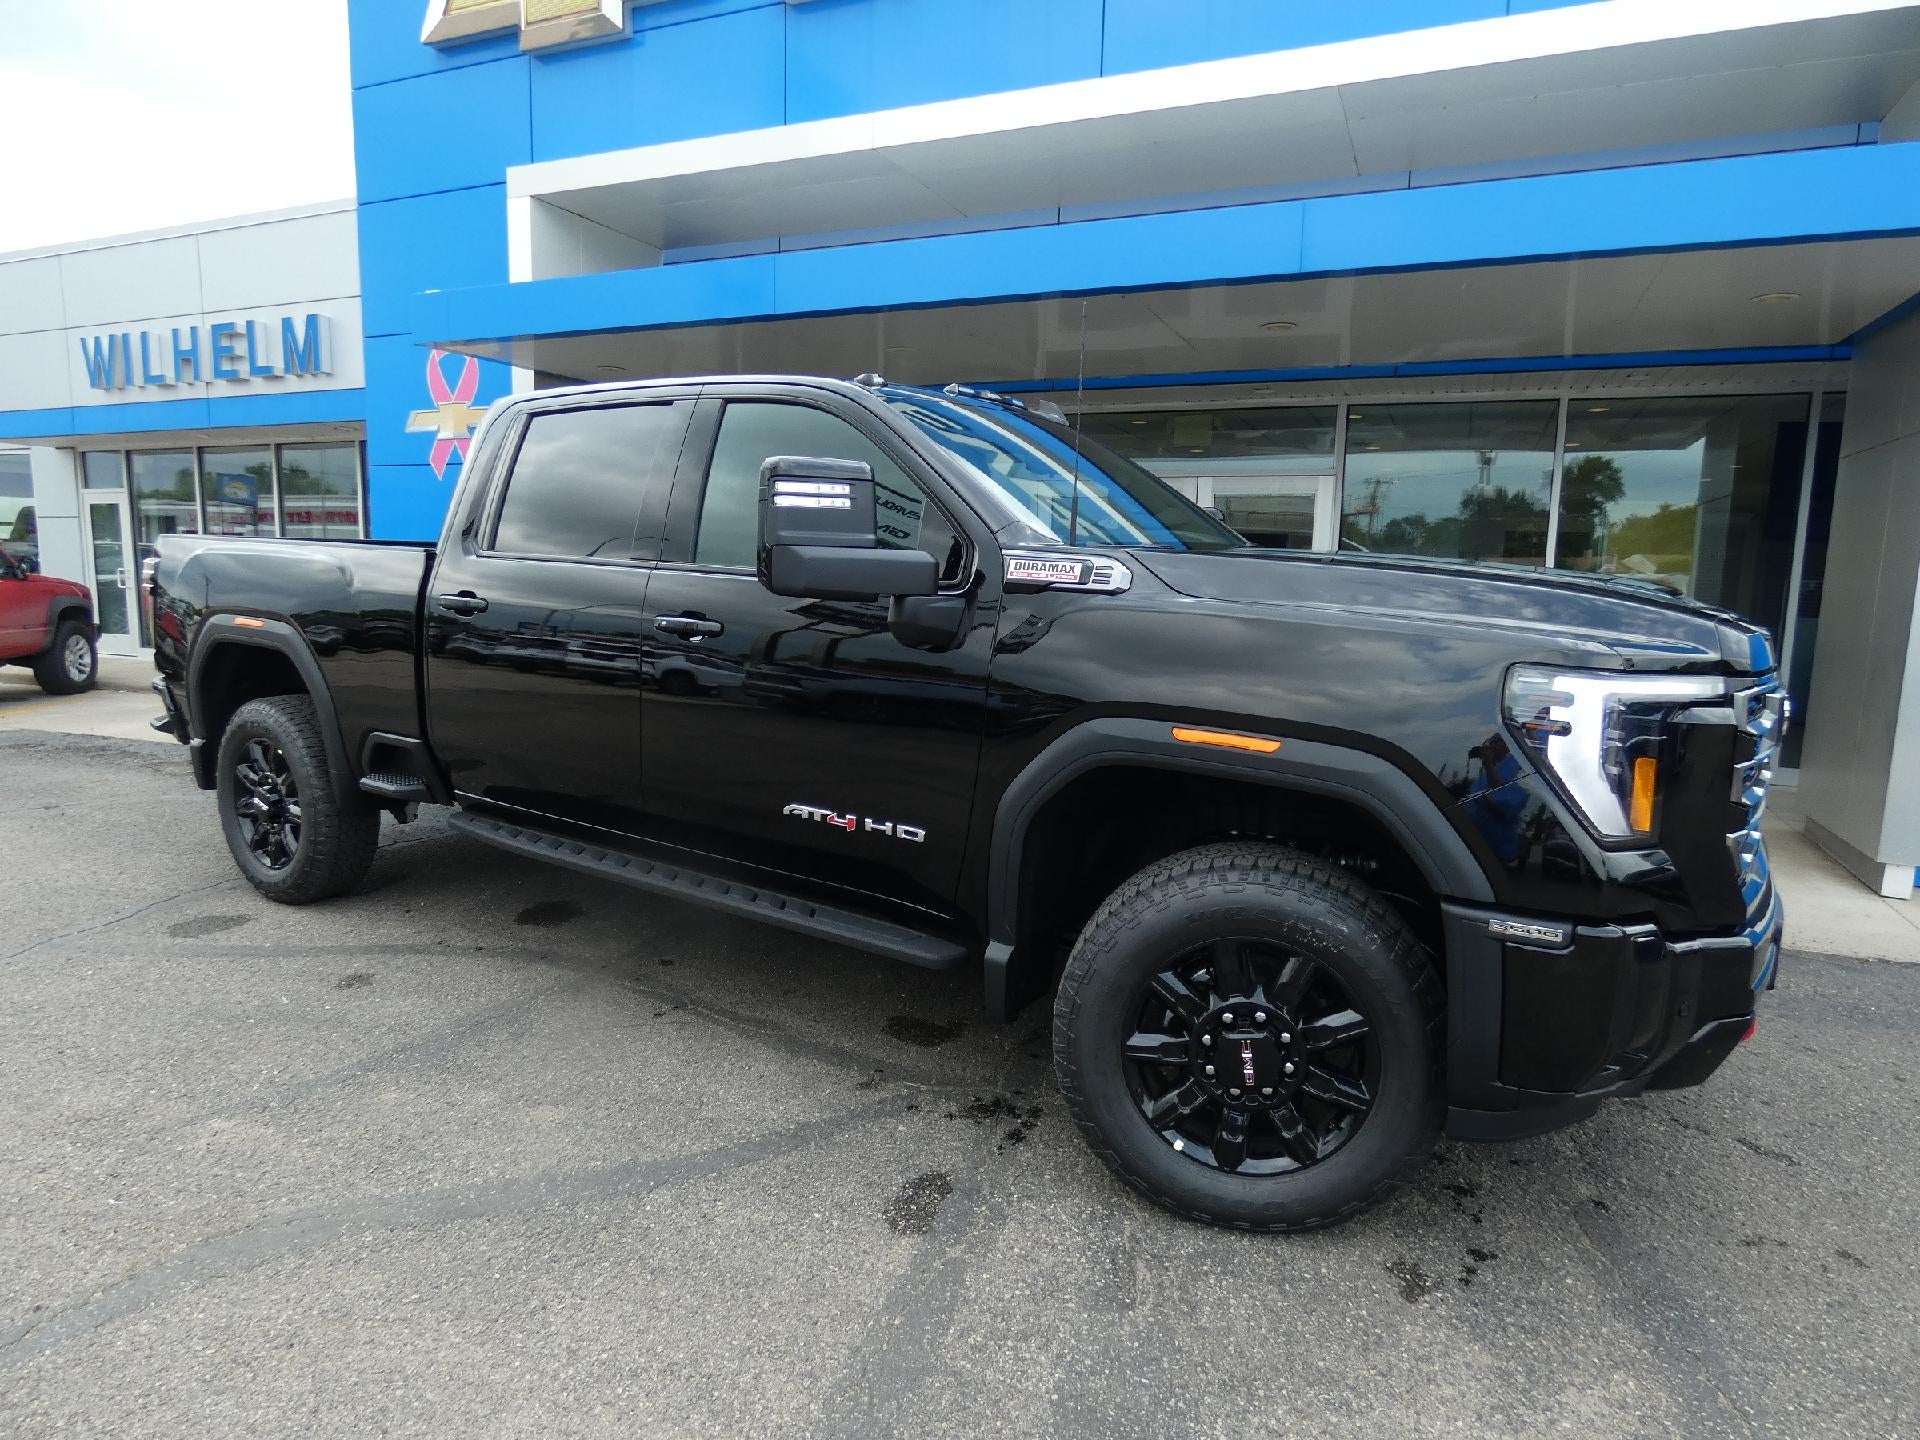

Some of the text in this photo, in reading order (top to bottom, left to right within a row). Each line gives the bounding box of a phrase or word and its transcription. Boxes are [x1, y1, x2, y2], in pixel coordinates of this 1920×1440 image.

[80, 313, 326, 391] WILHELM
[1013, 561, 1076, 574] DURAMAX
[783, 803, 927, 843] AT4 HD
[1240, 1039, 1255, 1086] GMC
